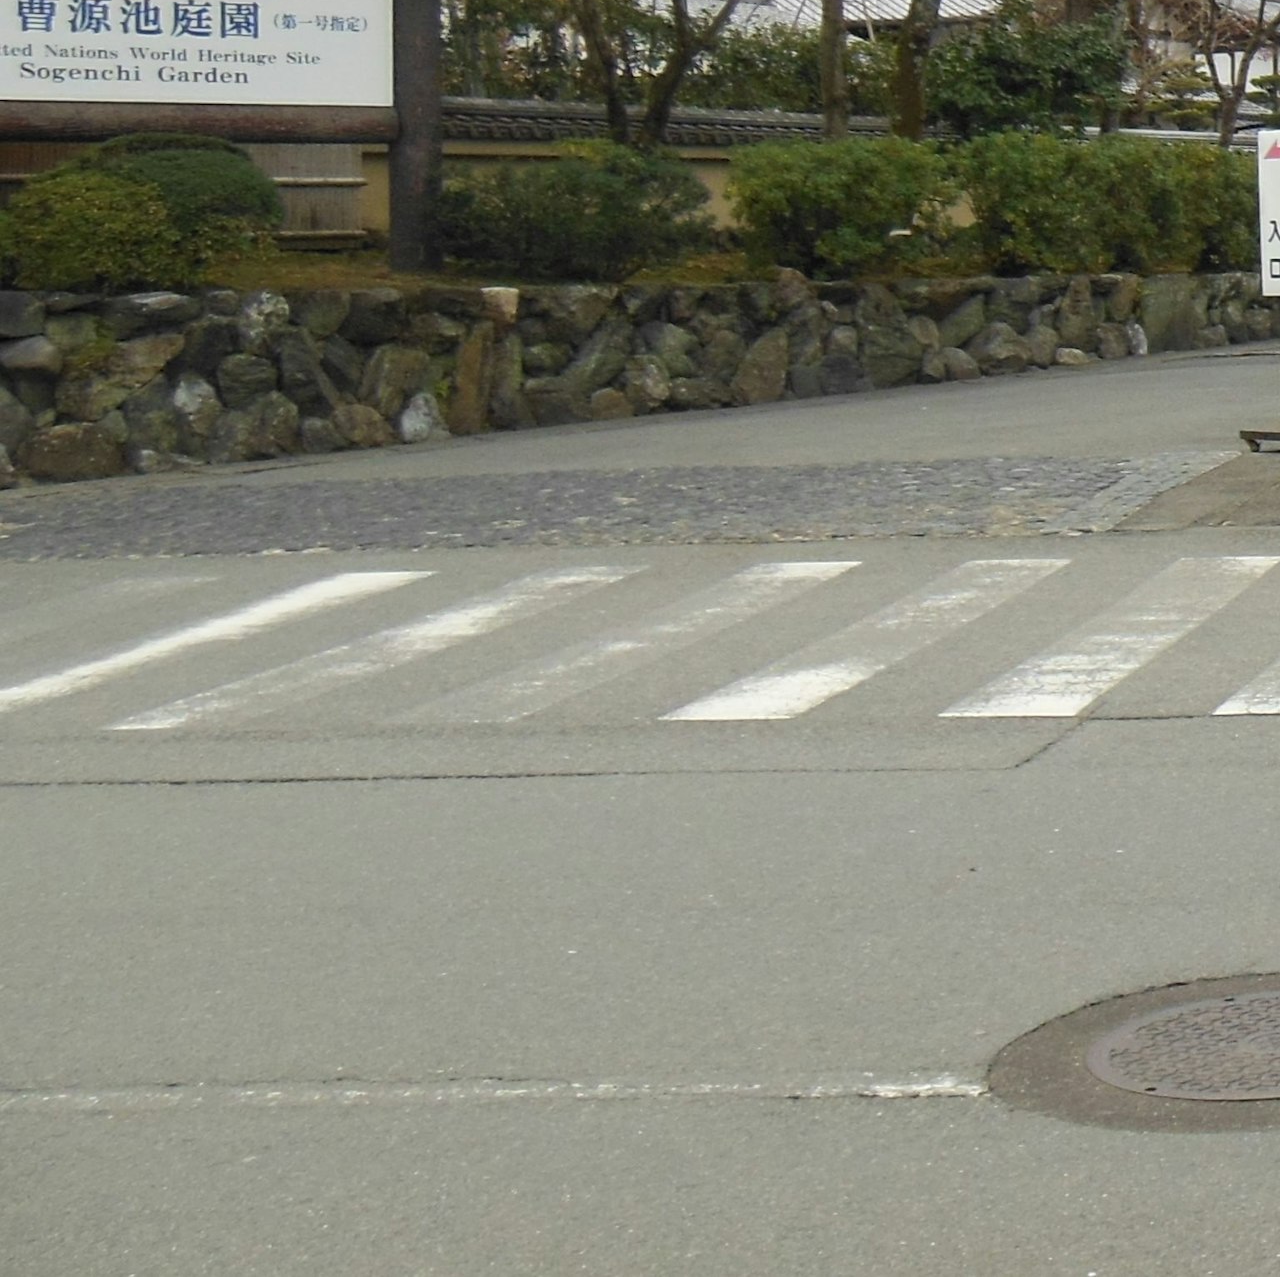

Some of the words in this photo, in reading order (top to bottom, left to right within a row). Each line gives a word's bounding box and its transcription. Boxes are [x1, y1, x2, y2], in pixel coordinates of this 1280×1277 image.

[0, 43, 33, 58] ted
[44, 44, 119, 60] Nations
[129, 46, 188, 62] World
[197, 49, 278, 67] Heritage
[285, 51, 321, 65] Site
[19, 61, 142, 84] Sogenchi
[157, 65, 249, 84] Garden
